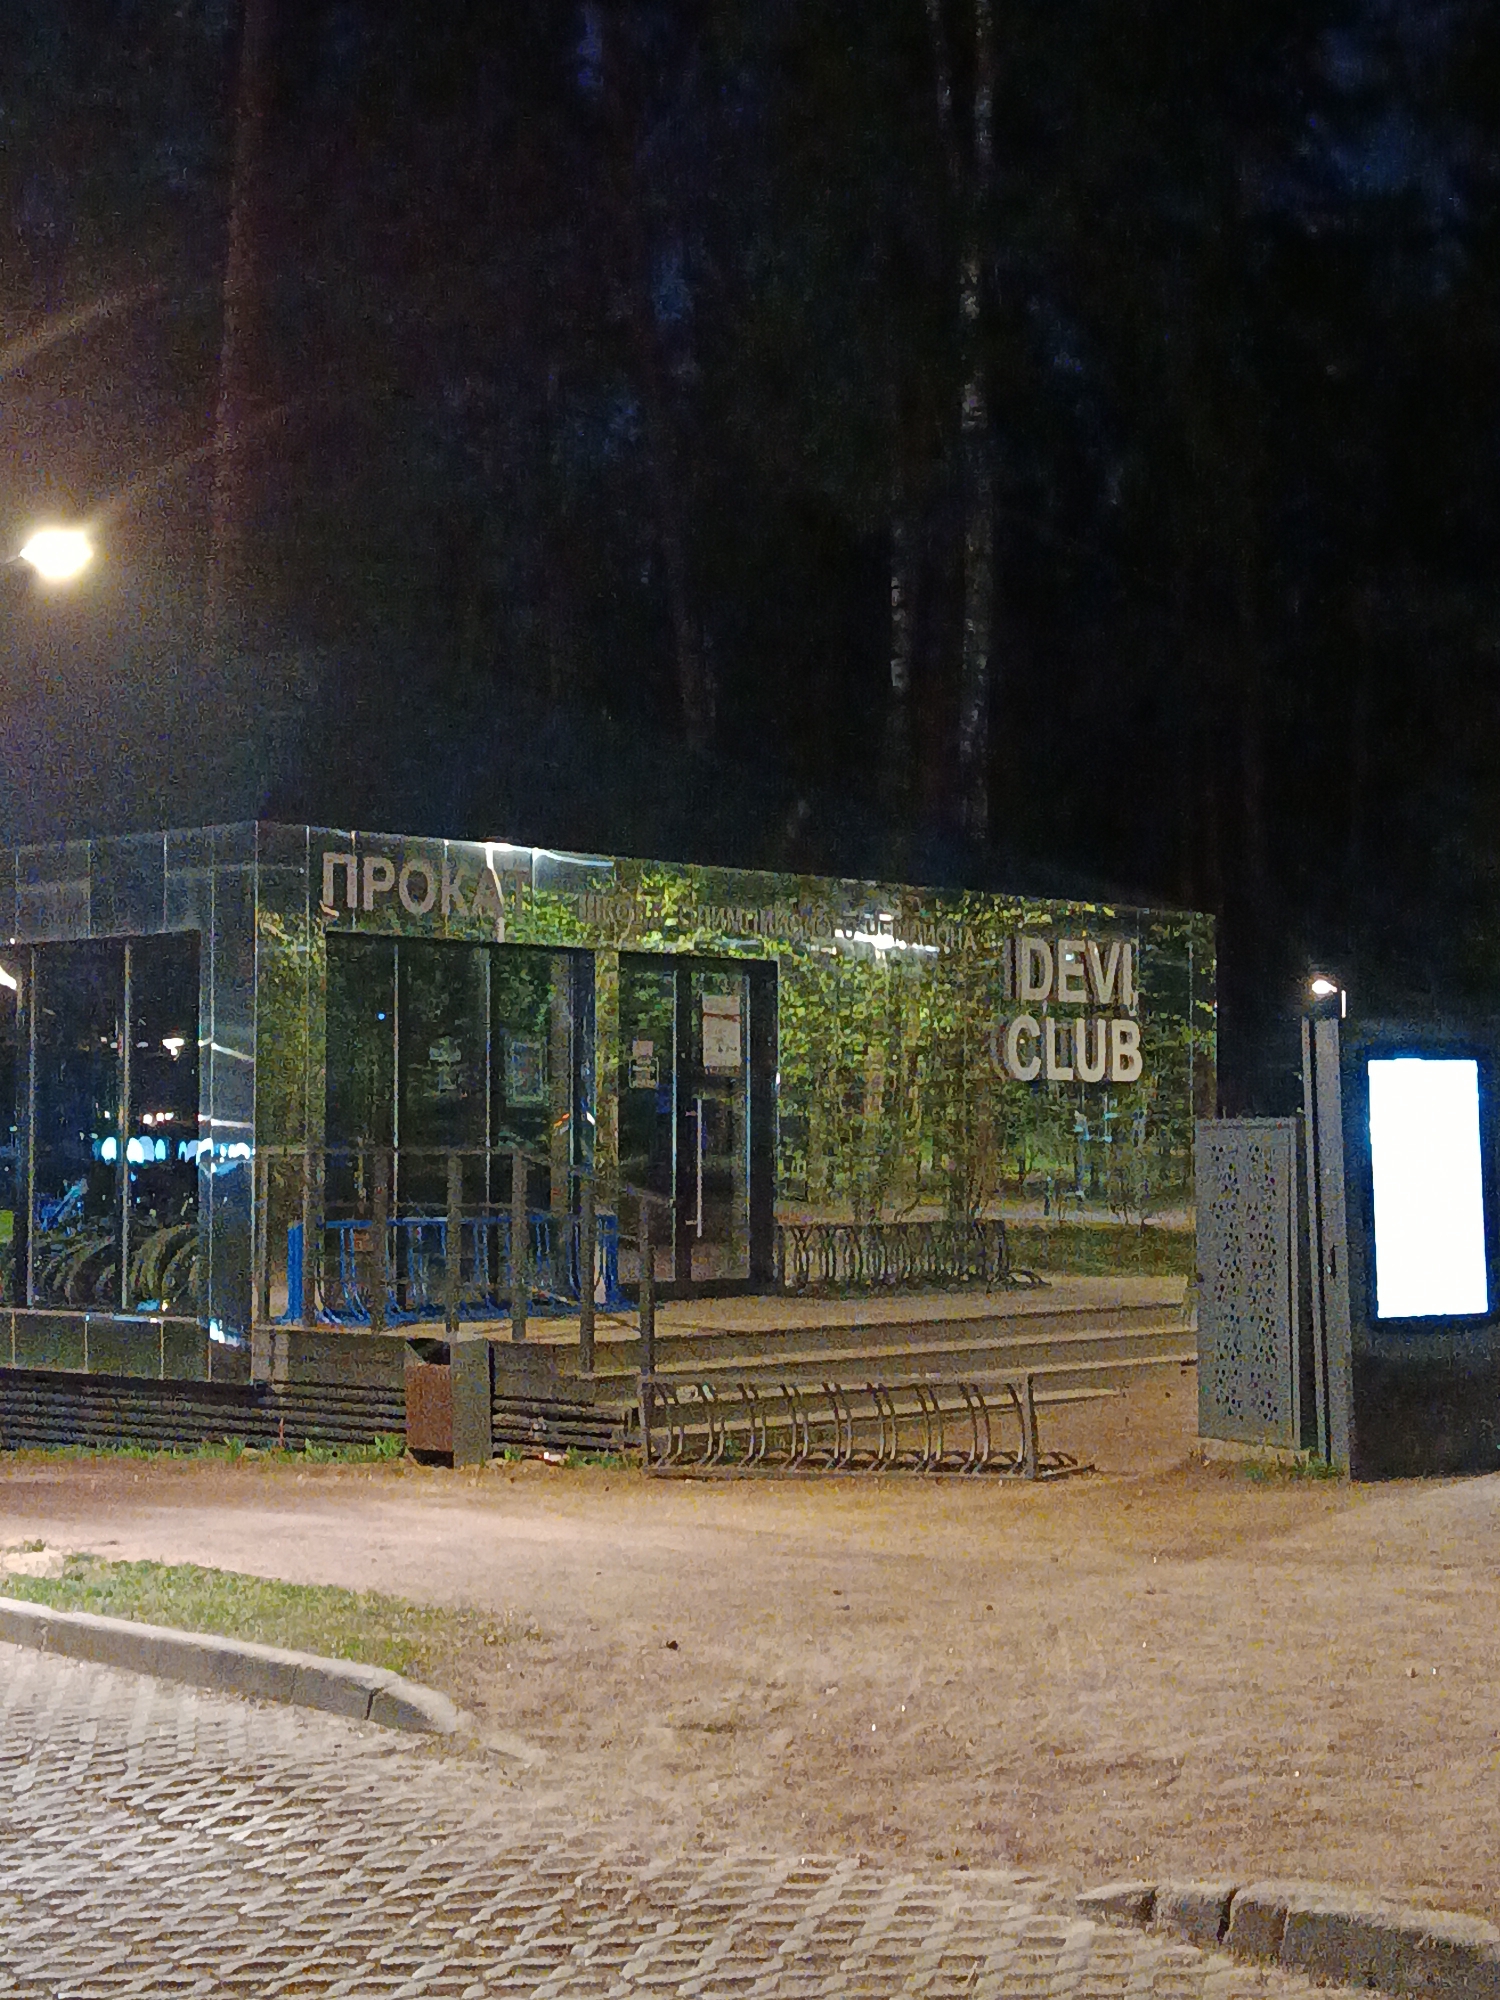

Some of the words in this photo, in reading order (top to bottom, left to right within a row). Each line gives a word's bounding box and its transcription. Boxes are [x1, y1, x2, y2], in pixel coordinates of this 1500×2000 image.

[321, 851, 529, 919] ПРОКАТ
[1020, 938, 1133, 1005] DEVI
[1007, 1014, 1143, 1083] CLUB
